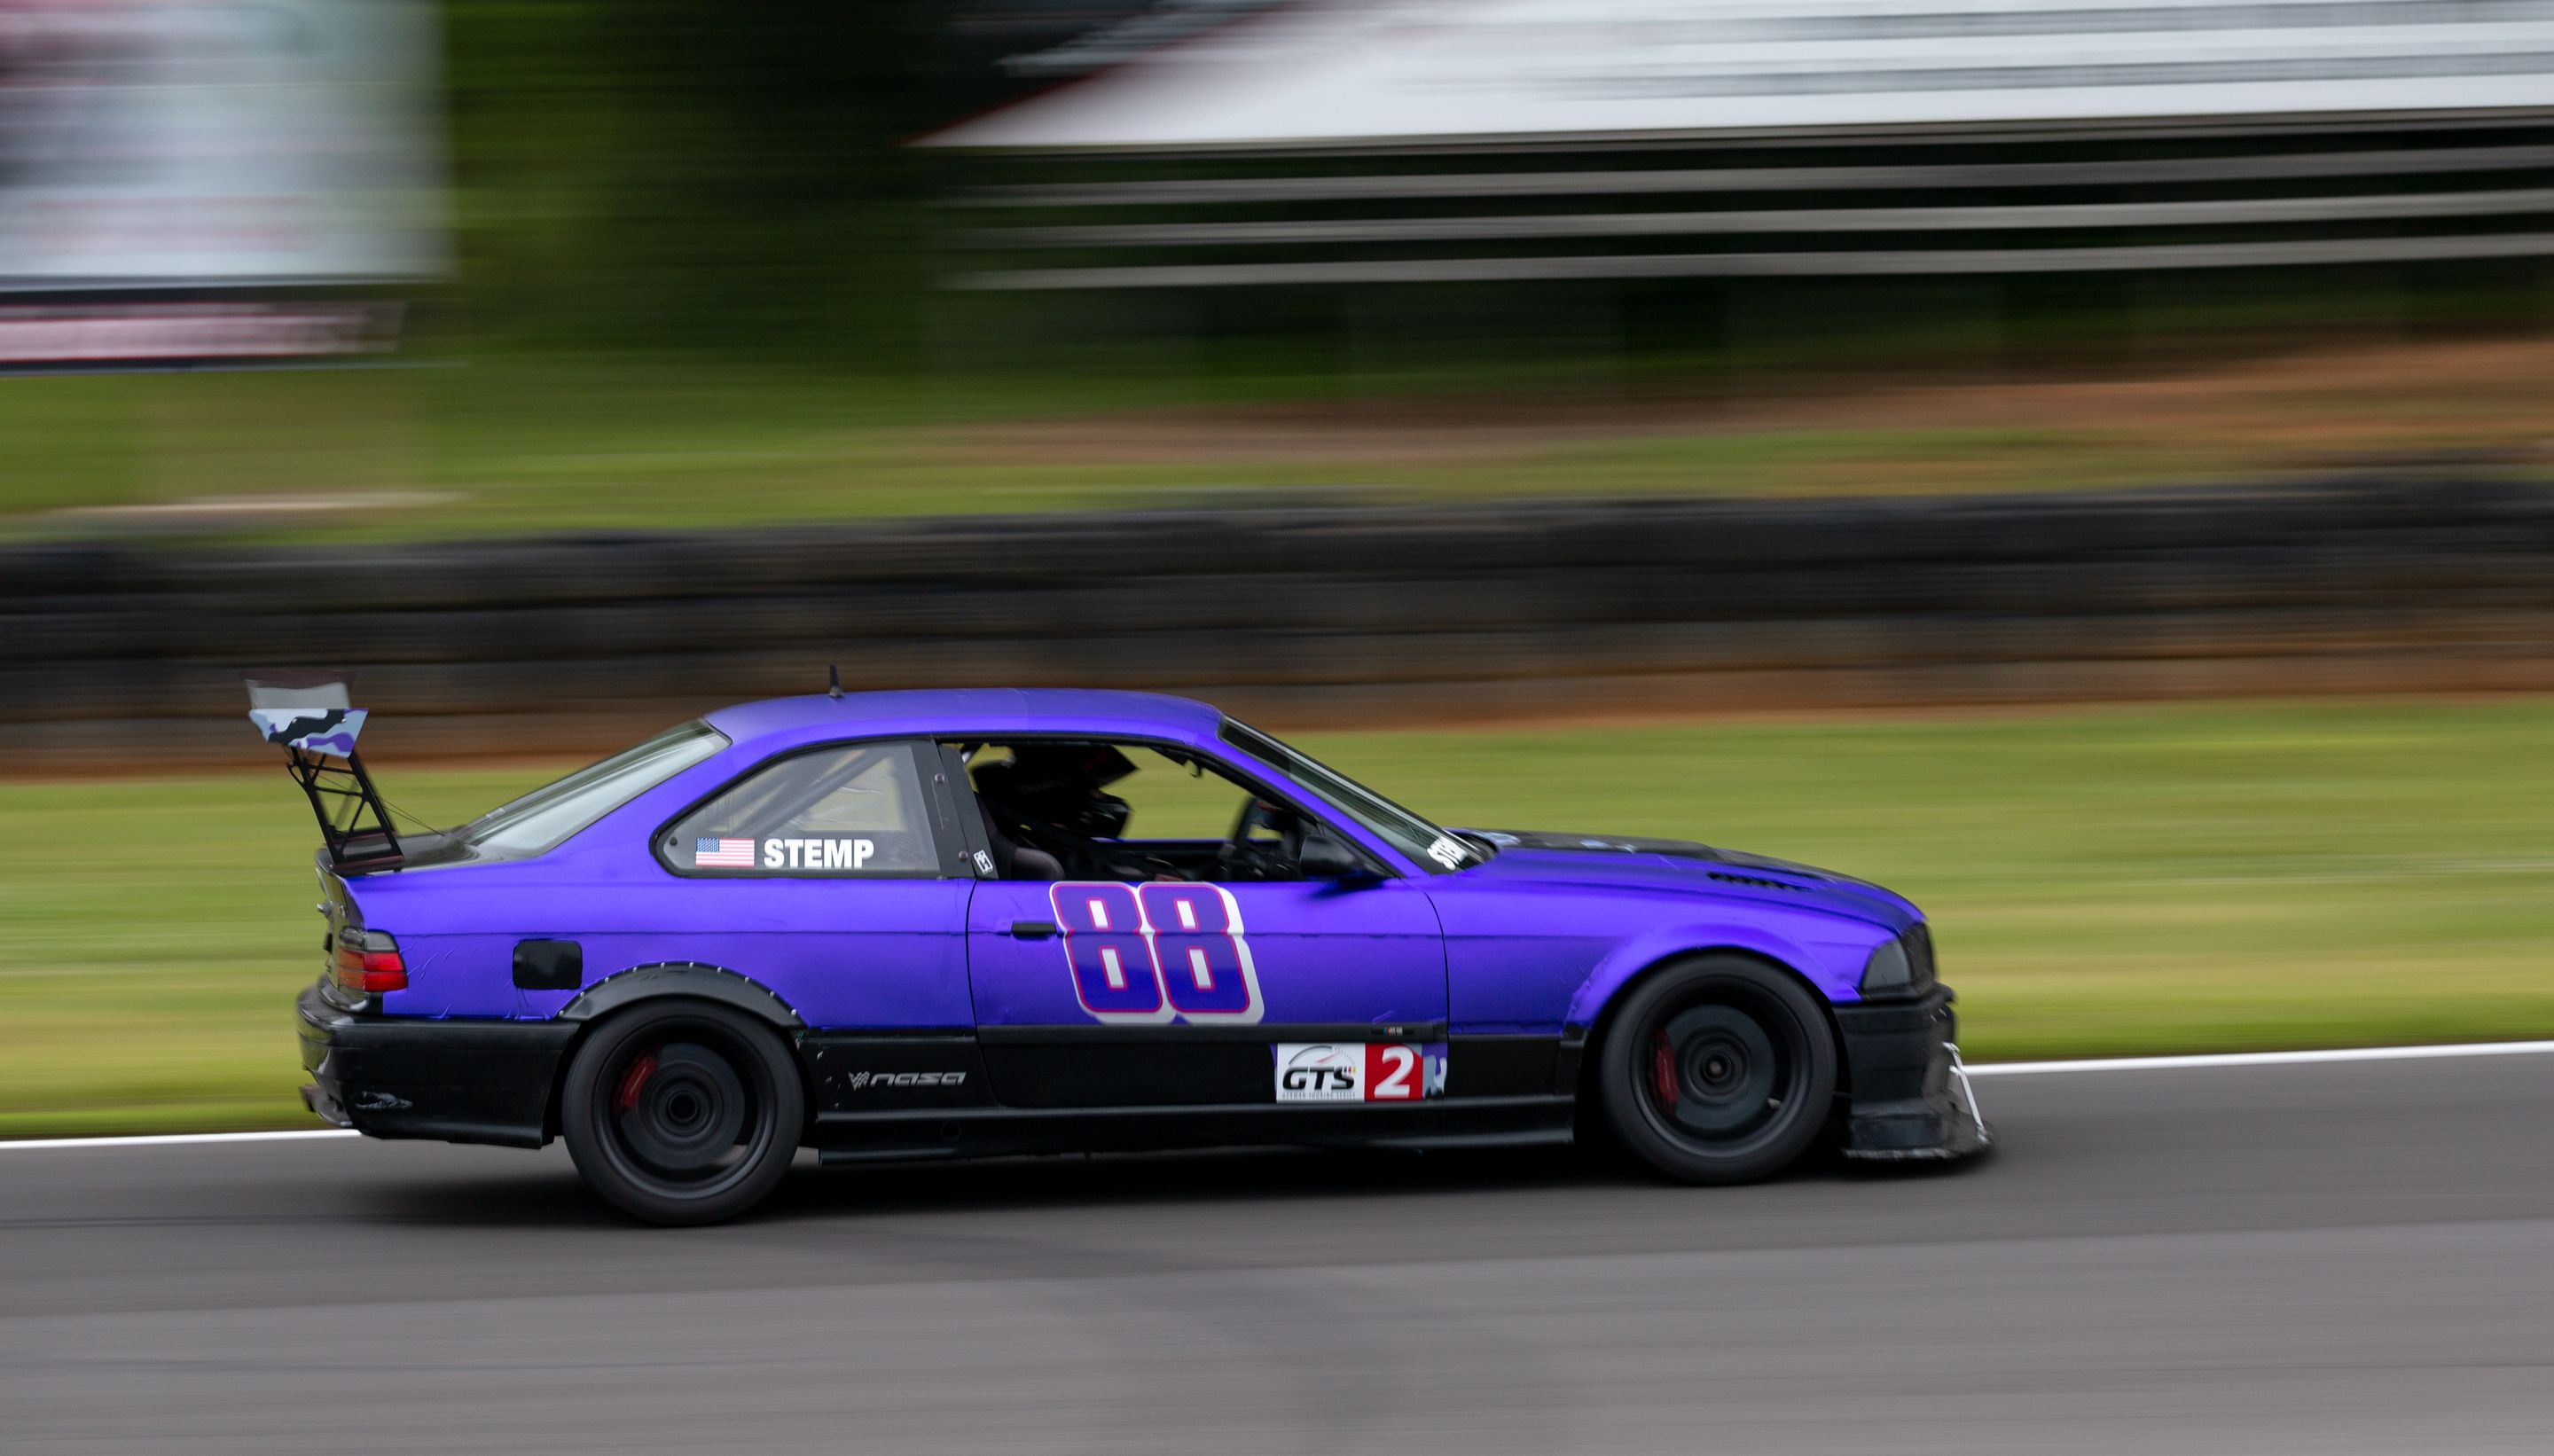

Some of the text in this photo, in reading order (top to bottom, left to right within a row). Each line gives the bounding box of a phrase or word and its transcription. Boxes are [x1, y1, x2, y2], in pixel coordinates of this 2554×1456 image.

[764, 838, 874, 868] STEMP
[1050, 881, 1265, 1026] 88
[1282, 1067, 1355, 1090] GTS
[1375, 1045, 1414, 1098] 2
